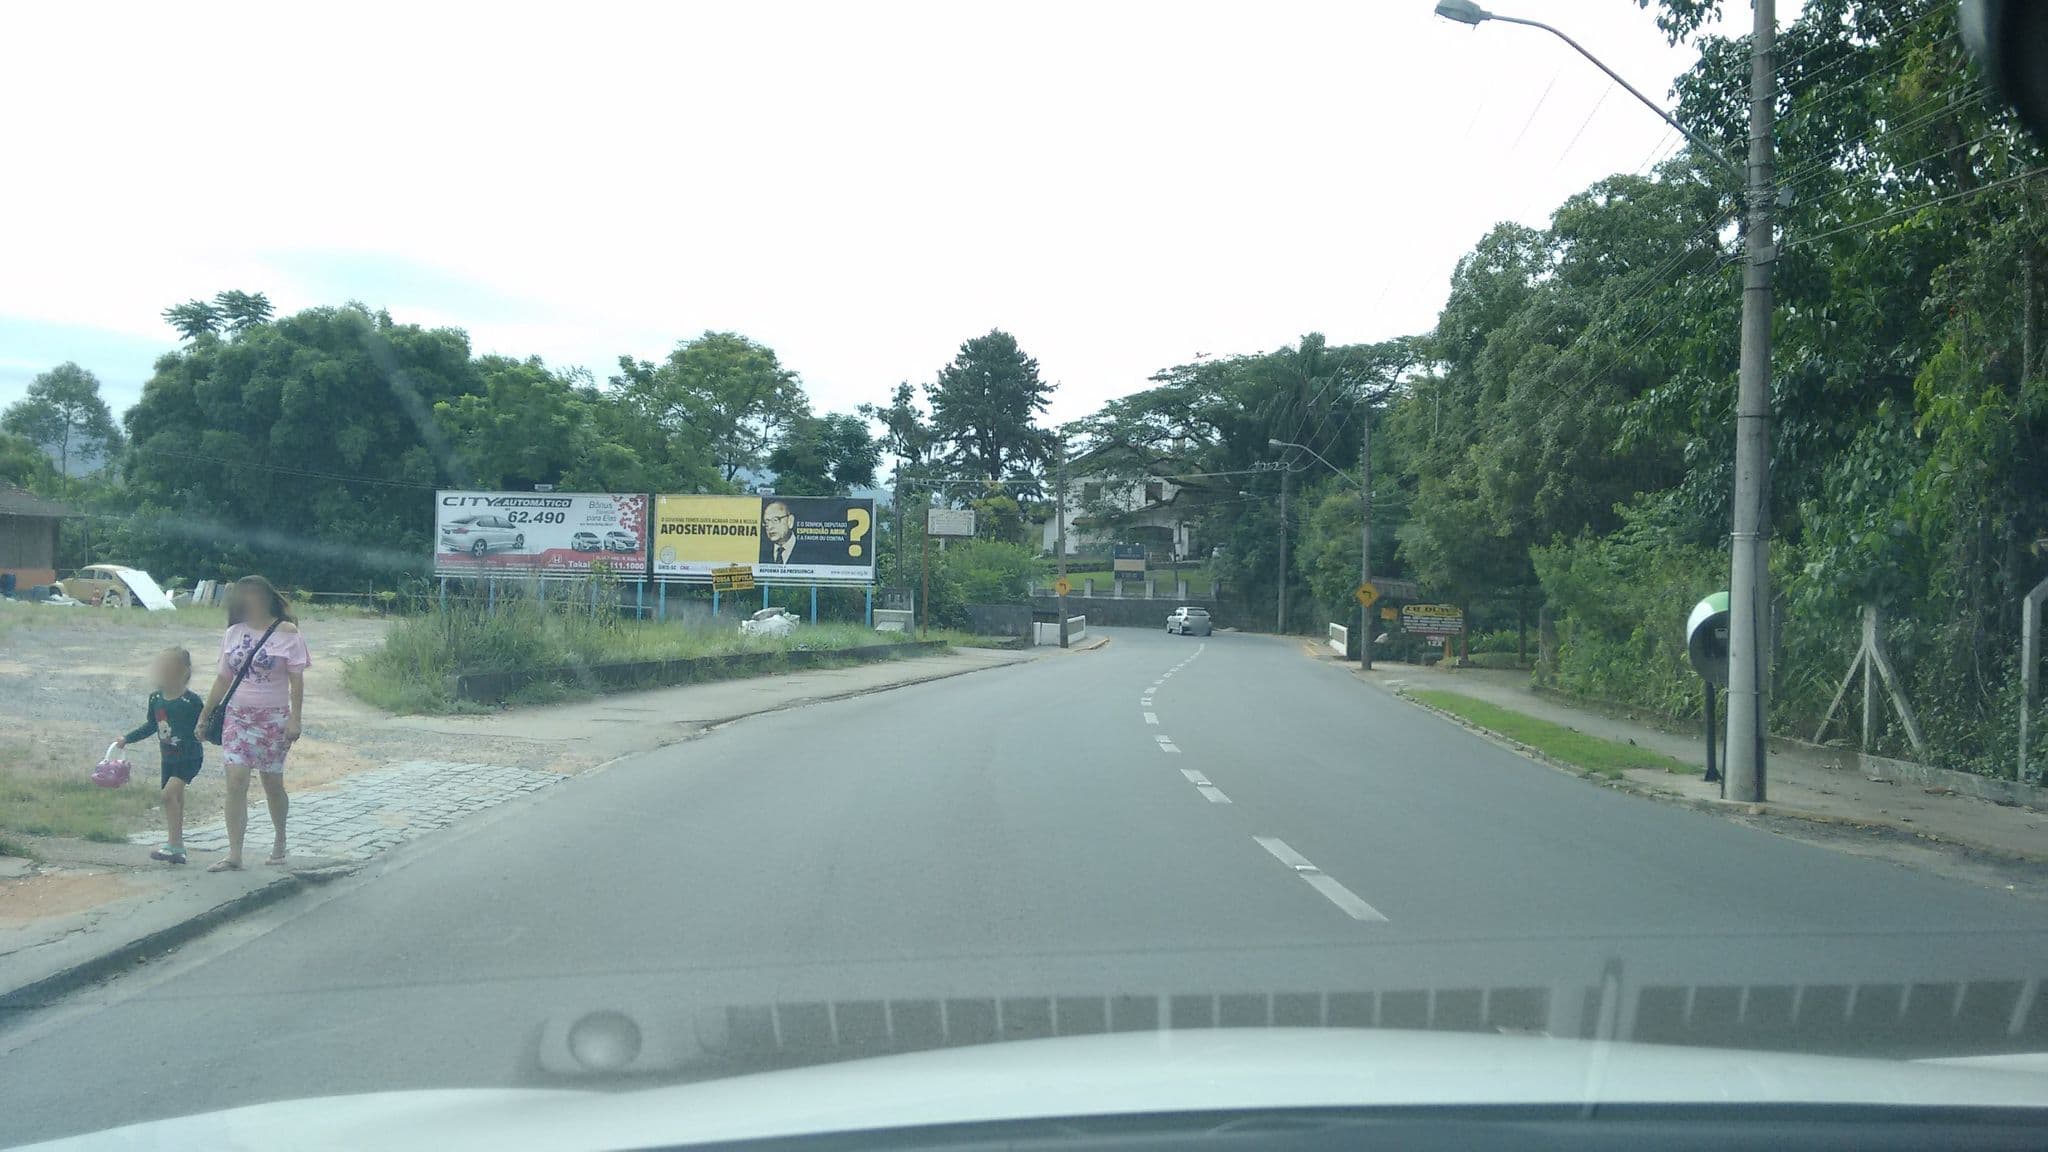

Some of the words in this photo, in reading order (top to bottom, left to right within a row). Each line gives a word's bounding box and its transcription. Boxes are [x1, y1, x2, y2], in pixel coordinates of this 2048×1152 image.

[443, 497, 499, 507] CITY
[589, 500, 613, 509] Bônus
[508, 511, 565, 524] 62.490
[660, 523, 758, 537] APOSENTADORIA
[847, 508, 871, 557] ?
